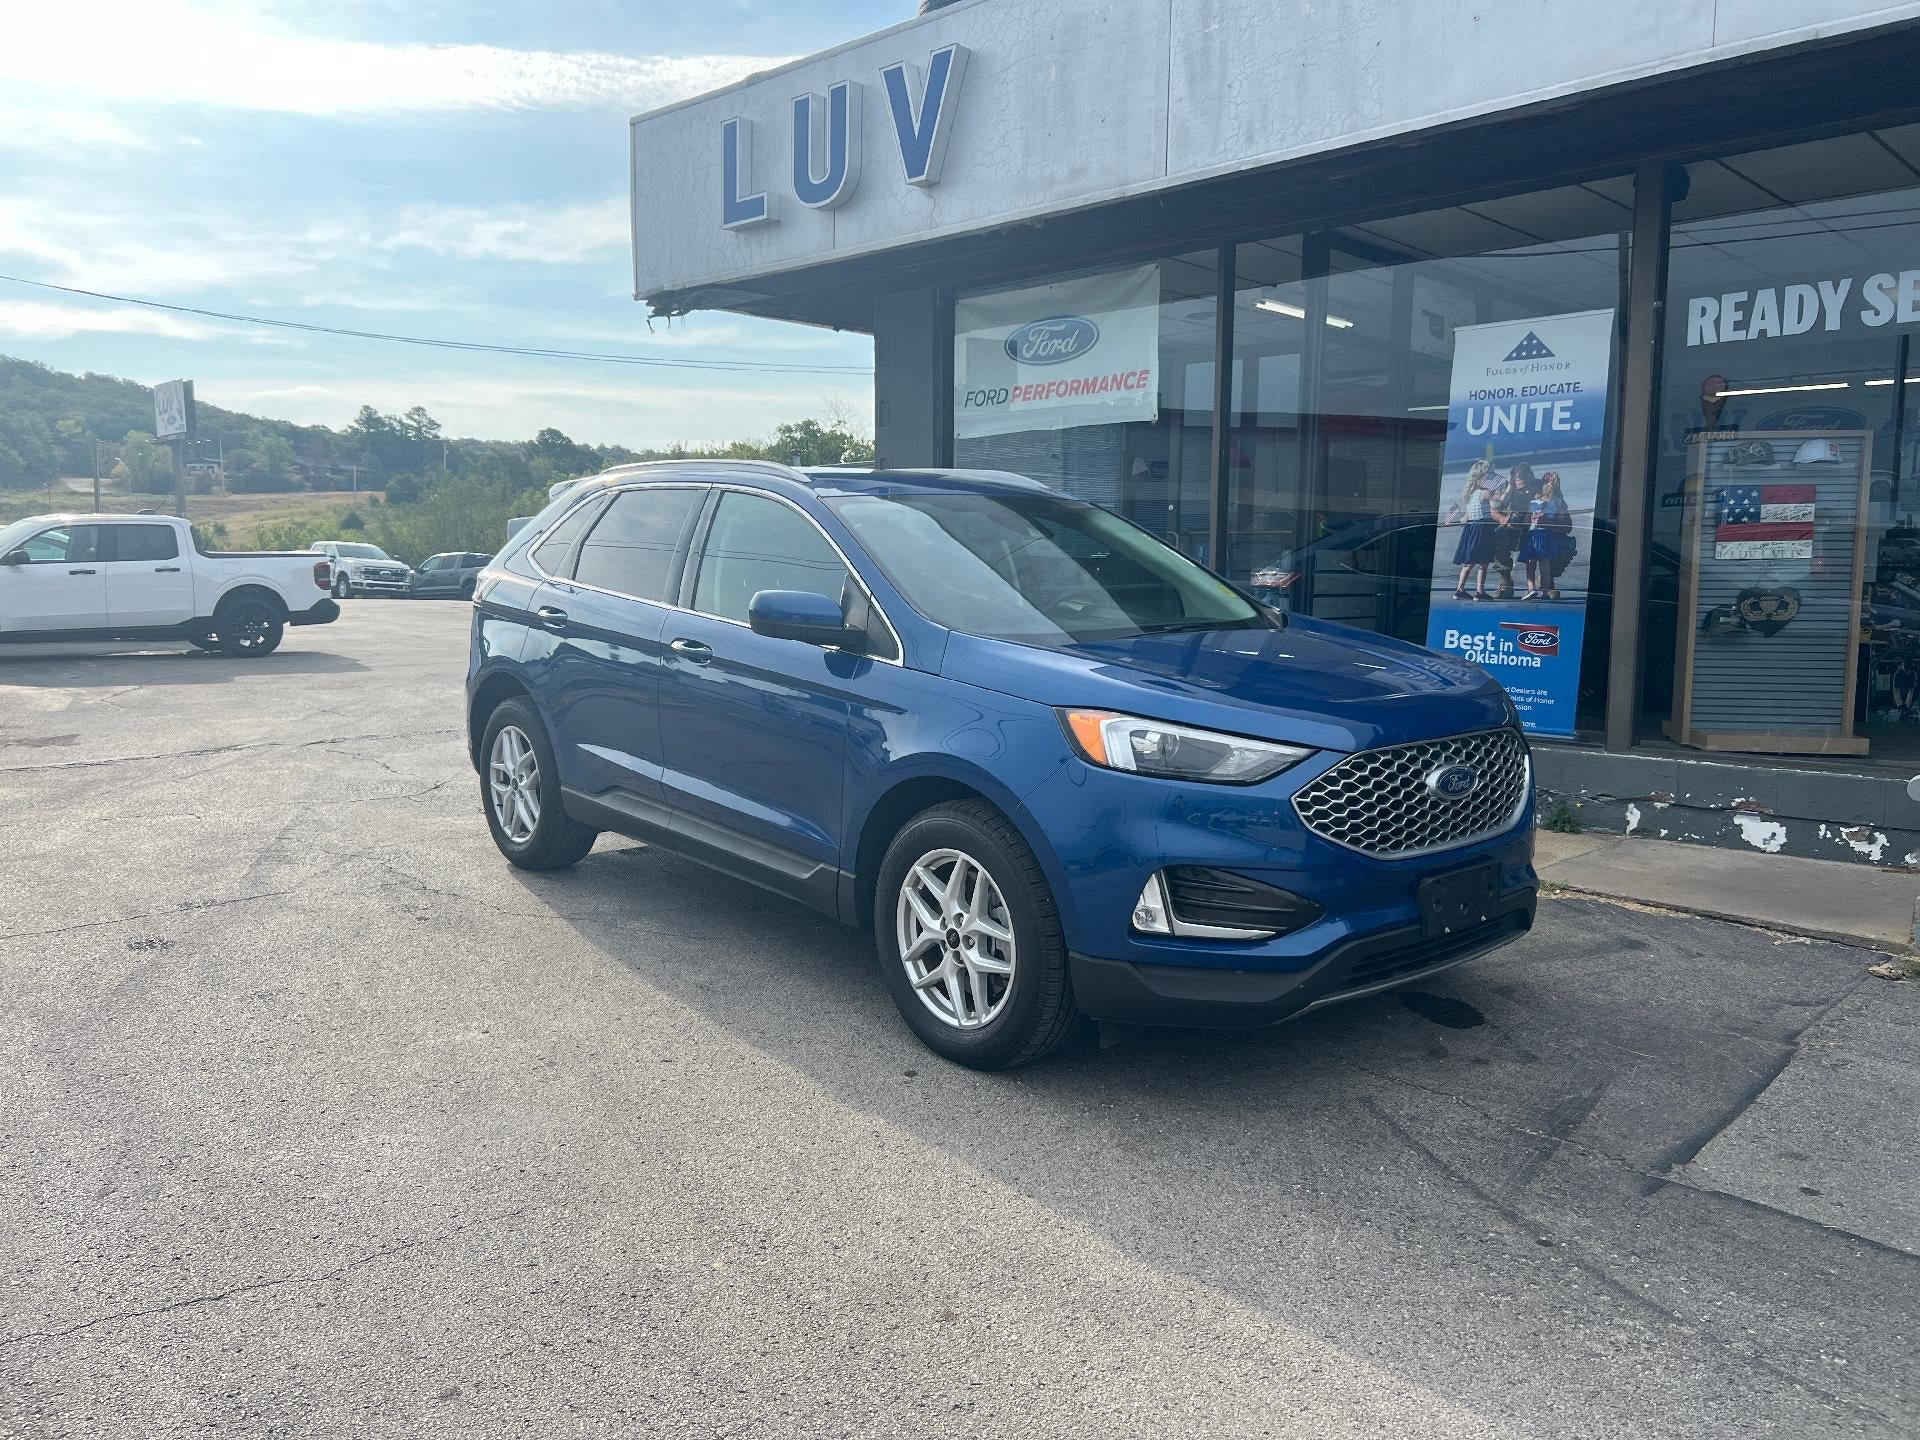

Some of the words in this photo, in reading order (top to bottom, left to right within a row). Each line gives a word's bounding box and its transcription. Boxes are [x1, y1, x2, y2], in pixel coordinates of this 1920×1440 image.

[720, 43, 970, 231] LUV
[1686, 277, 1853, 347] READY
[1022, 323, 1080, 359] Ford
[964, 387, 1009, 408] FORD
[1010, 369, 1151, 403] PERFORMANCE
[1469, 387, 1518, 401] HONOR.
[1521, 381, 1584, 397] EDUCATE.
[1466, 400, 1581, 436] UNITE.
[1444, 629, 1495, 651] Best
[1499, 639, 1513, 653] in
[1524, 632, 1552, 647] Ford
[1464, 650, 1541, 668] Oklahoma
[1510, 686, 1536, 695] Dealers
[1514, 703, 1534, 711] ssion.
[1447, 775, 1471, 791] Ford
